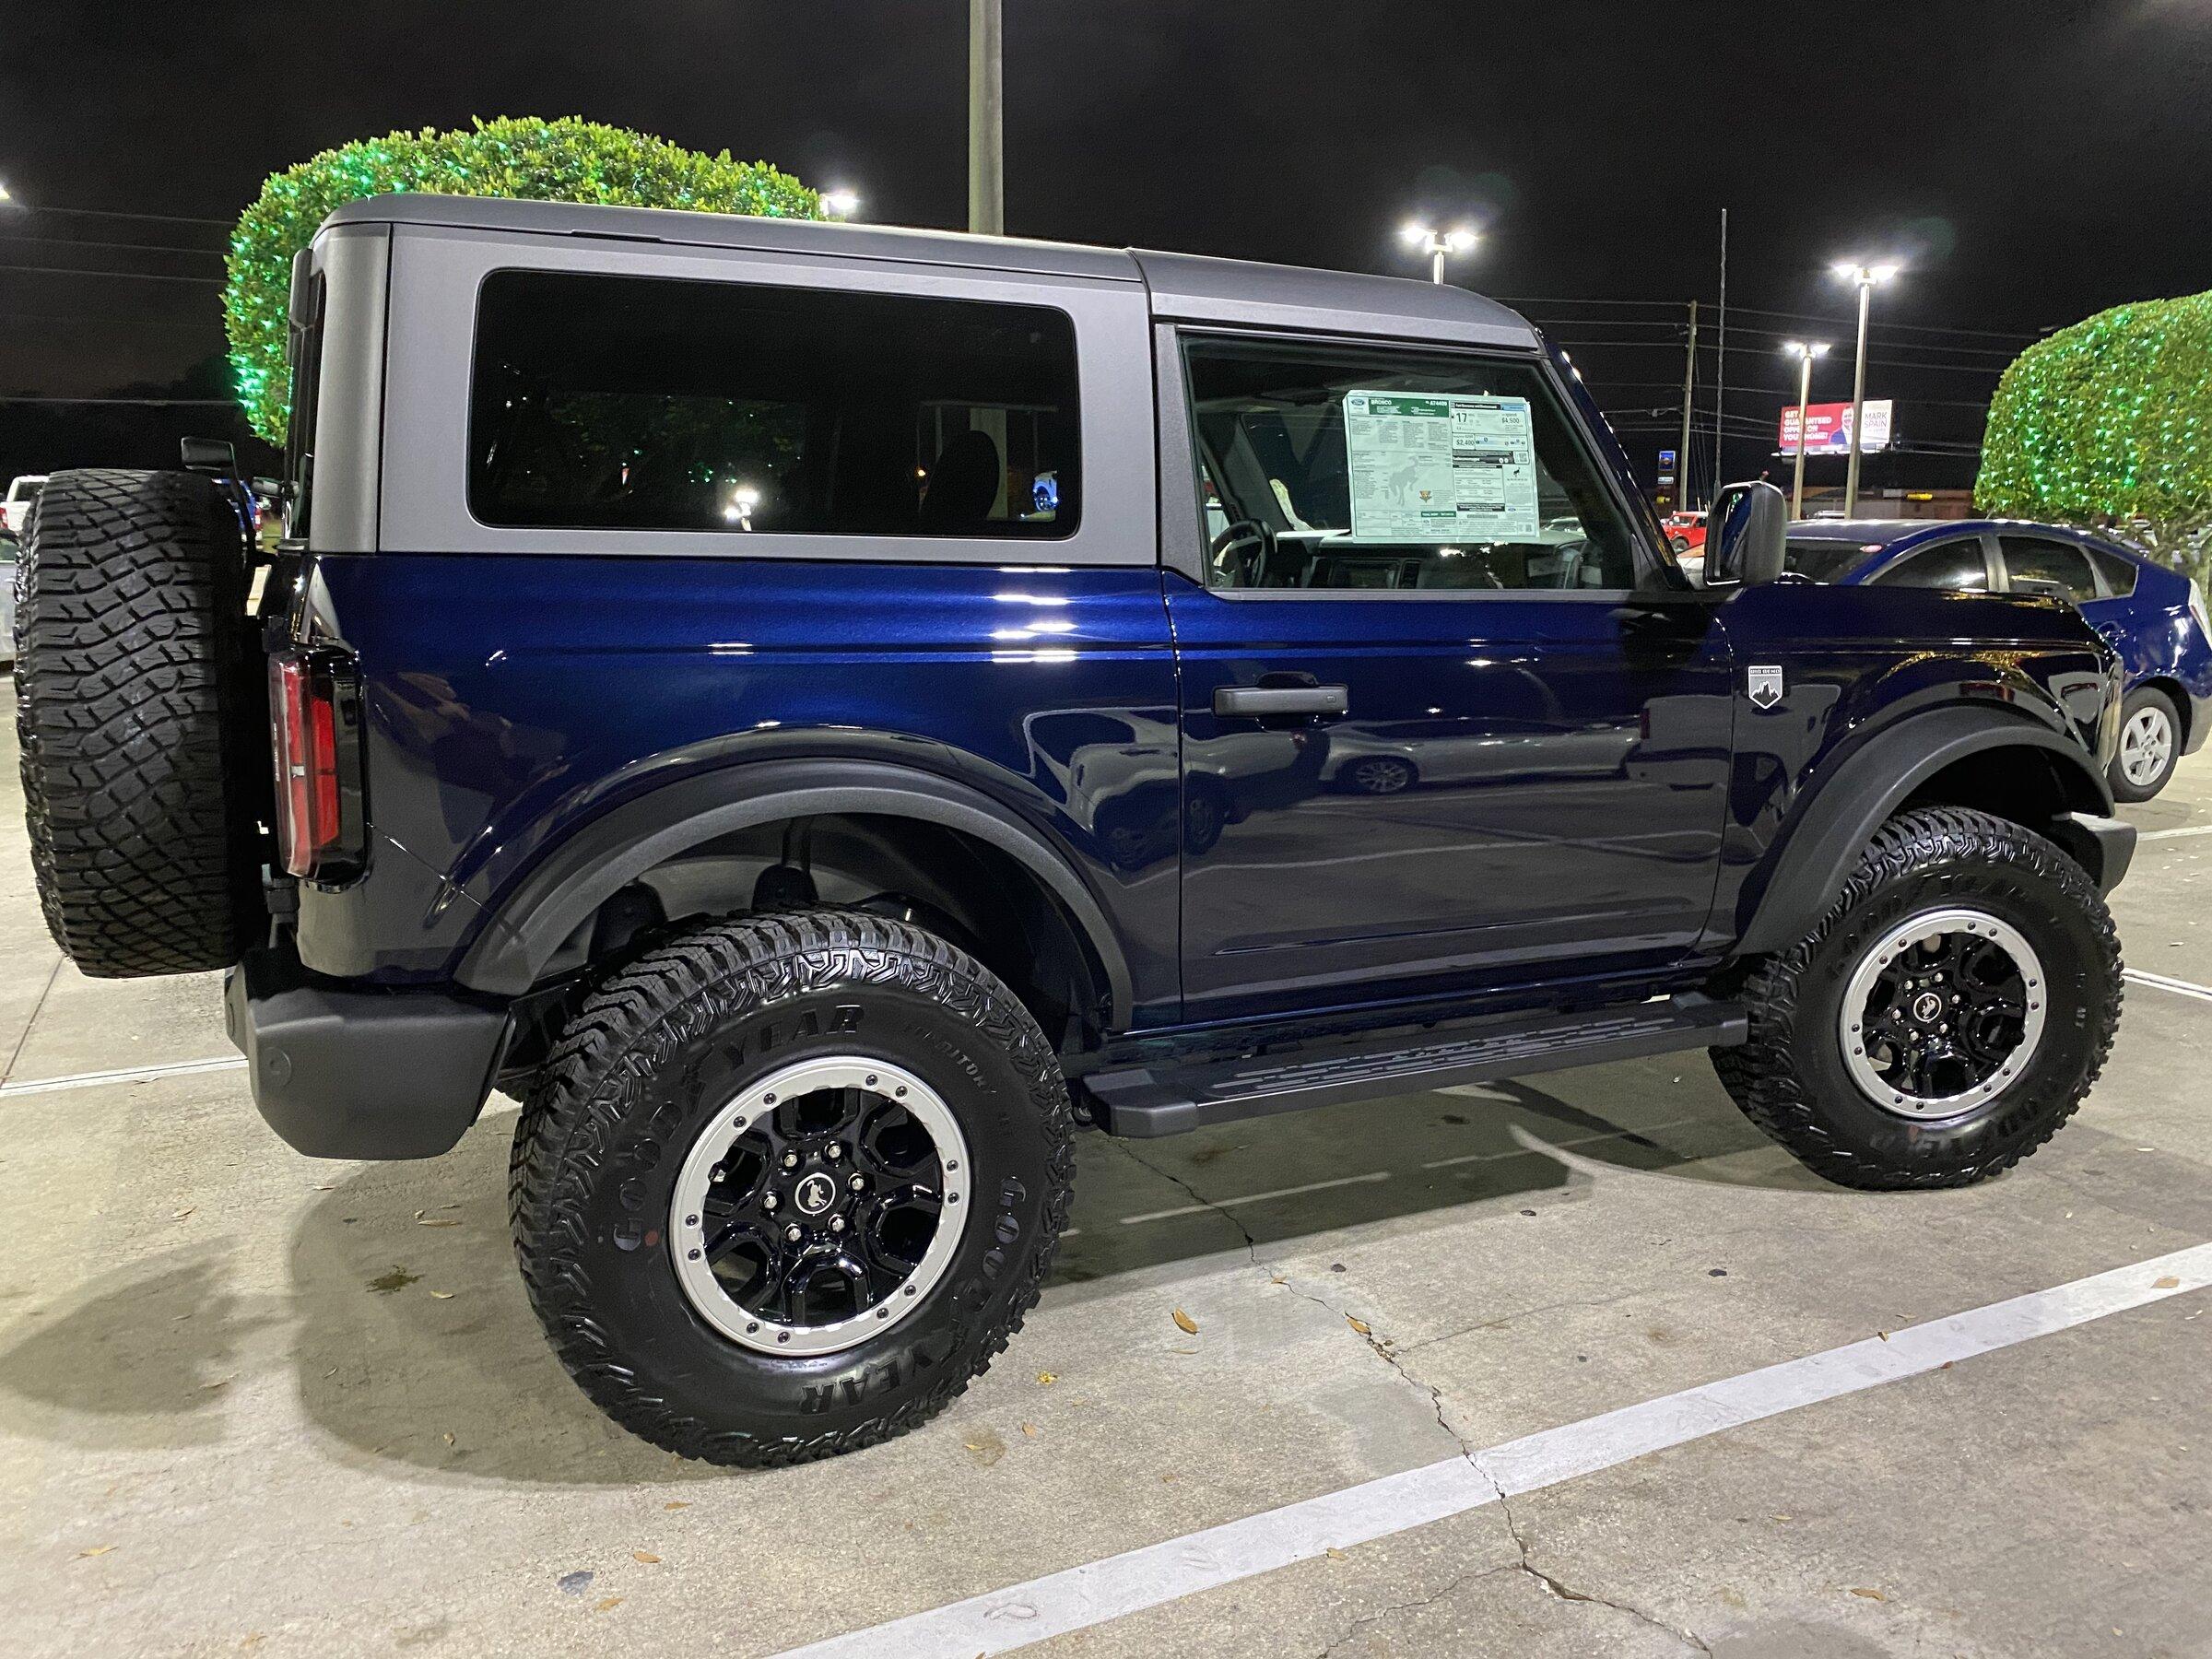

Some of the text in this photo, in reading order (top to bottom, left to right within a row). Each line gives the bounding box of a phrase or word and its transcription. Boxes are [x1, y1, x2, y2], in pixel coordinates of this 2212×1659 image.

[1456, 412, 1467, 422] 17
[1784, 410, 1799, 418] GET
[1784, 417, 1832, 426] GUAANTEED
[1783, 433, 1799, 441] YOU
